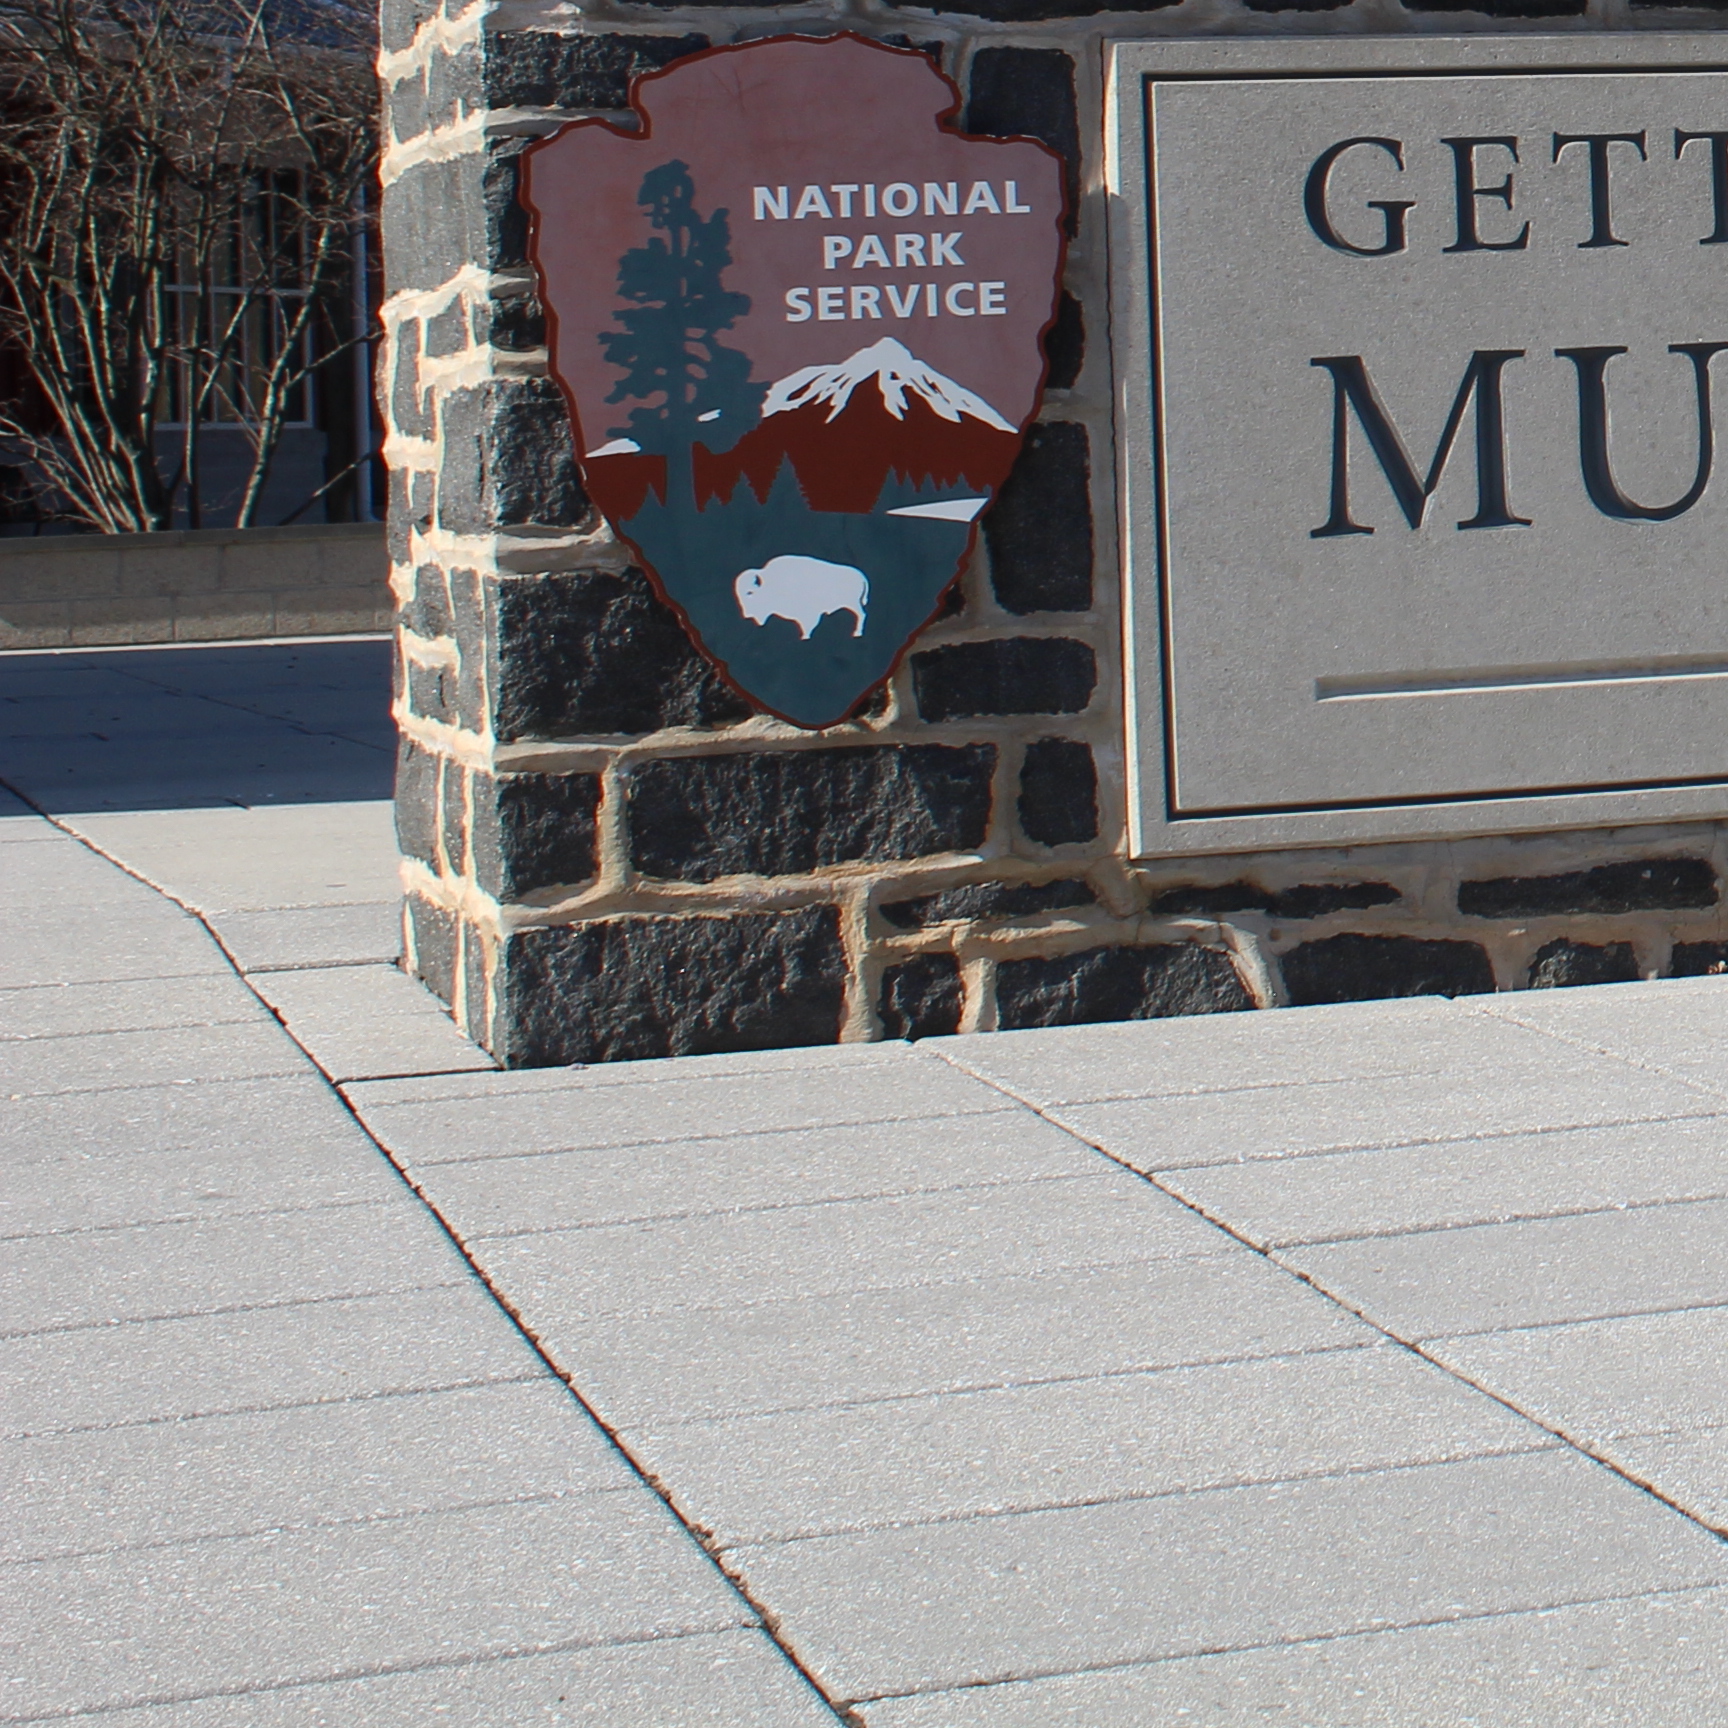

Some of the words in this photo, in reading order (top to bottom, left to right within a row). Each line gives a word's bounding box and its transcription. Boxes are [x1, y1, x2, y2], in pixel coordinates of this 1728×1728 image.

[752, 179, 1033, 221] NATIONAL
[822, 231, 967, 271] PARK
[784, 280, 1008, 323] SERVICE
